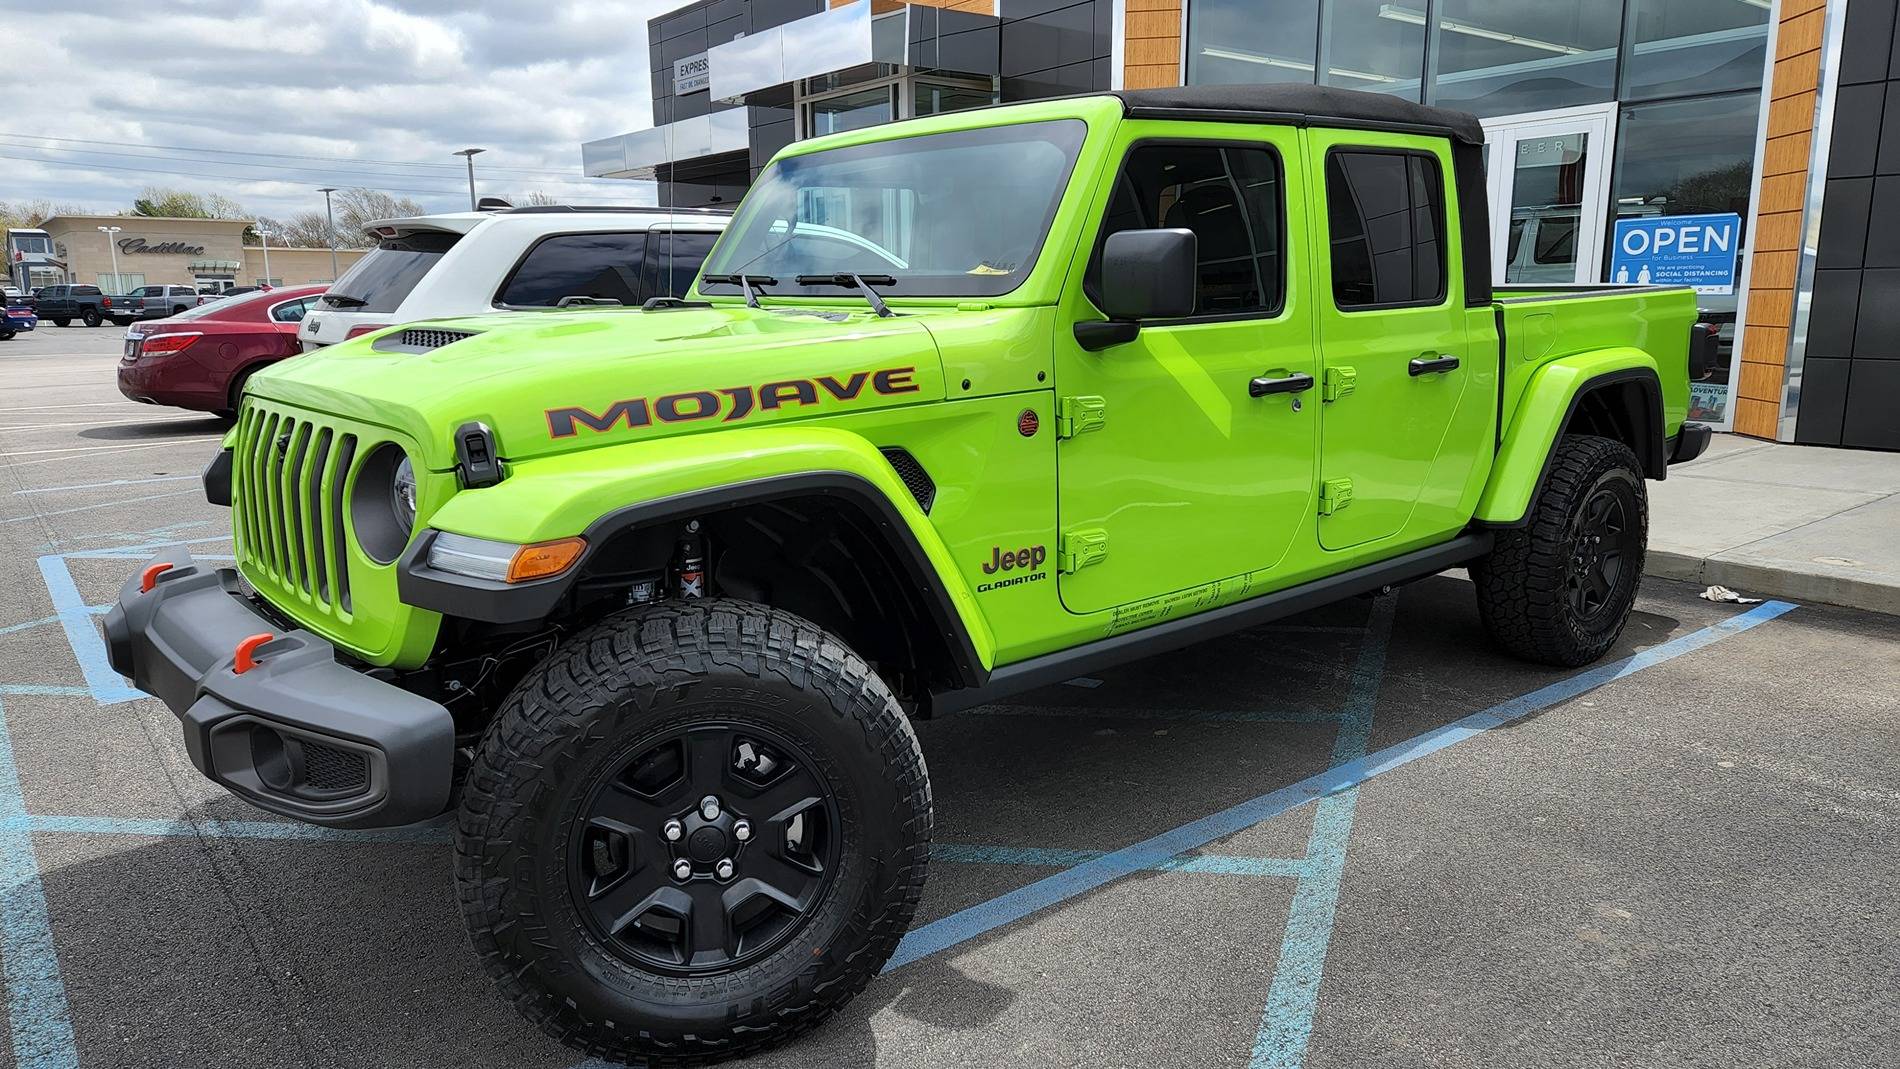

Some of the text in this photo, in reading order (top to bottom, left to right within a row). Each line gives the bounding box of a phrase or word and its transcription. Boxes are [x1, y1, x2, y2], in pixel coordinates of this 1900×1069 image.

[117, 238, 204, 255] Cadillac
[1622, 225, 1730, 255] OPEN
[544, 366, 920, 439] MOJAVE
[982, 545, 1046, 574] Jeep
[977, 572, 1046, 592] GLADIATOR
